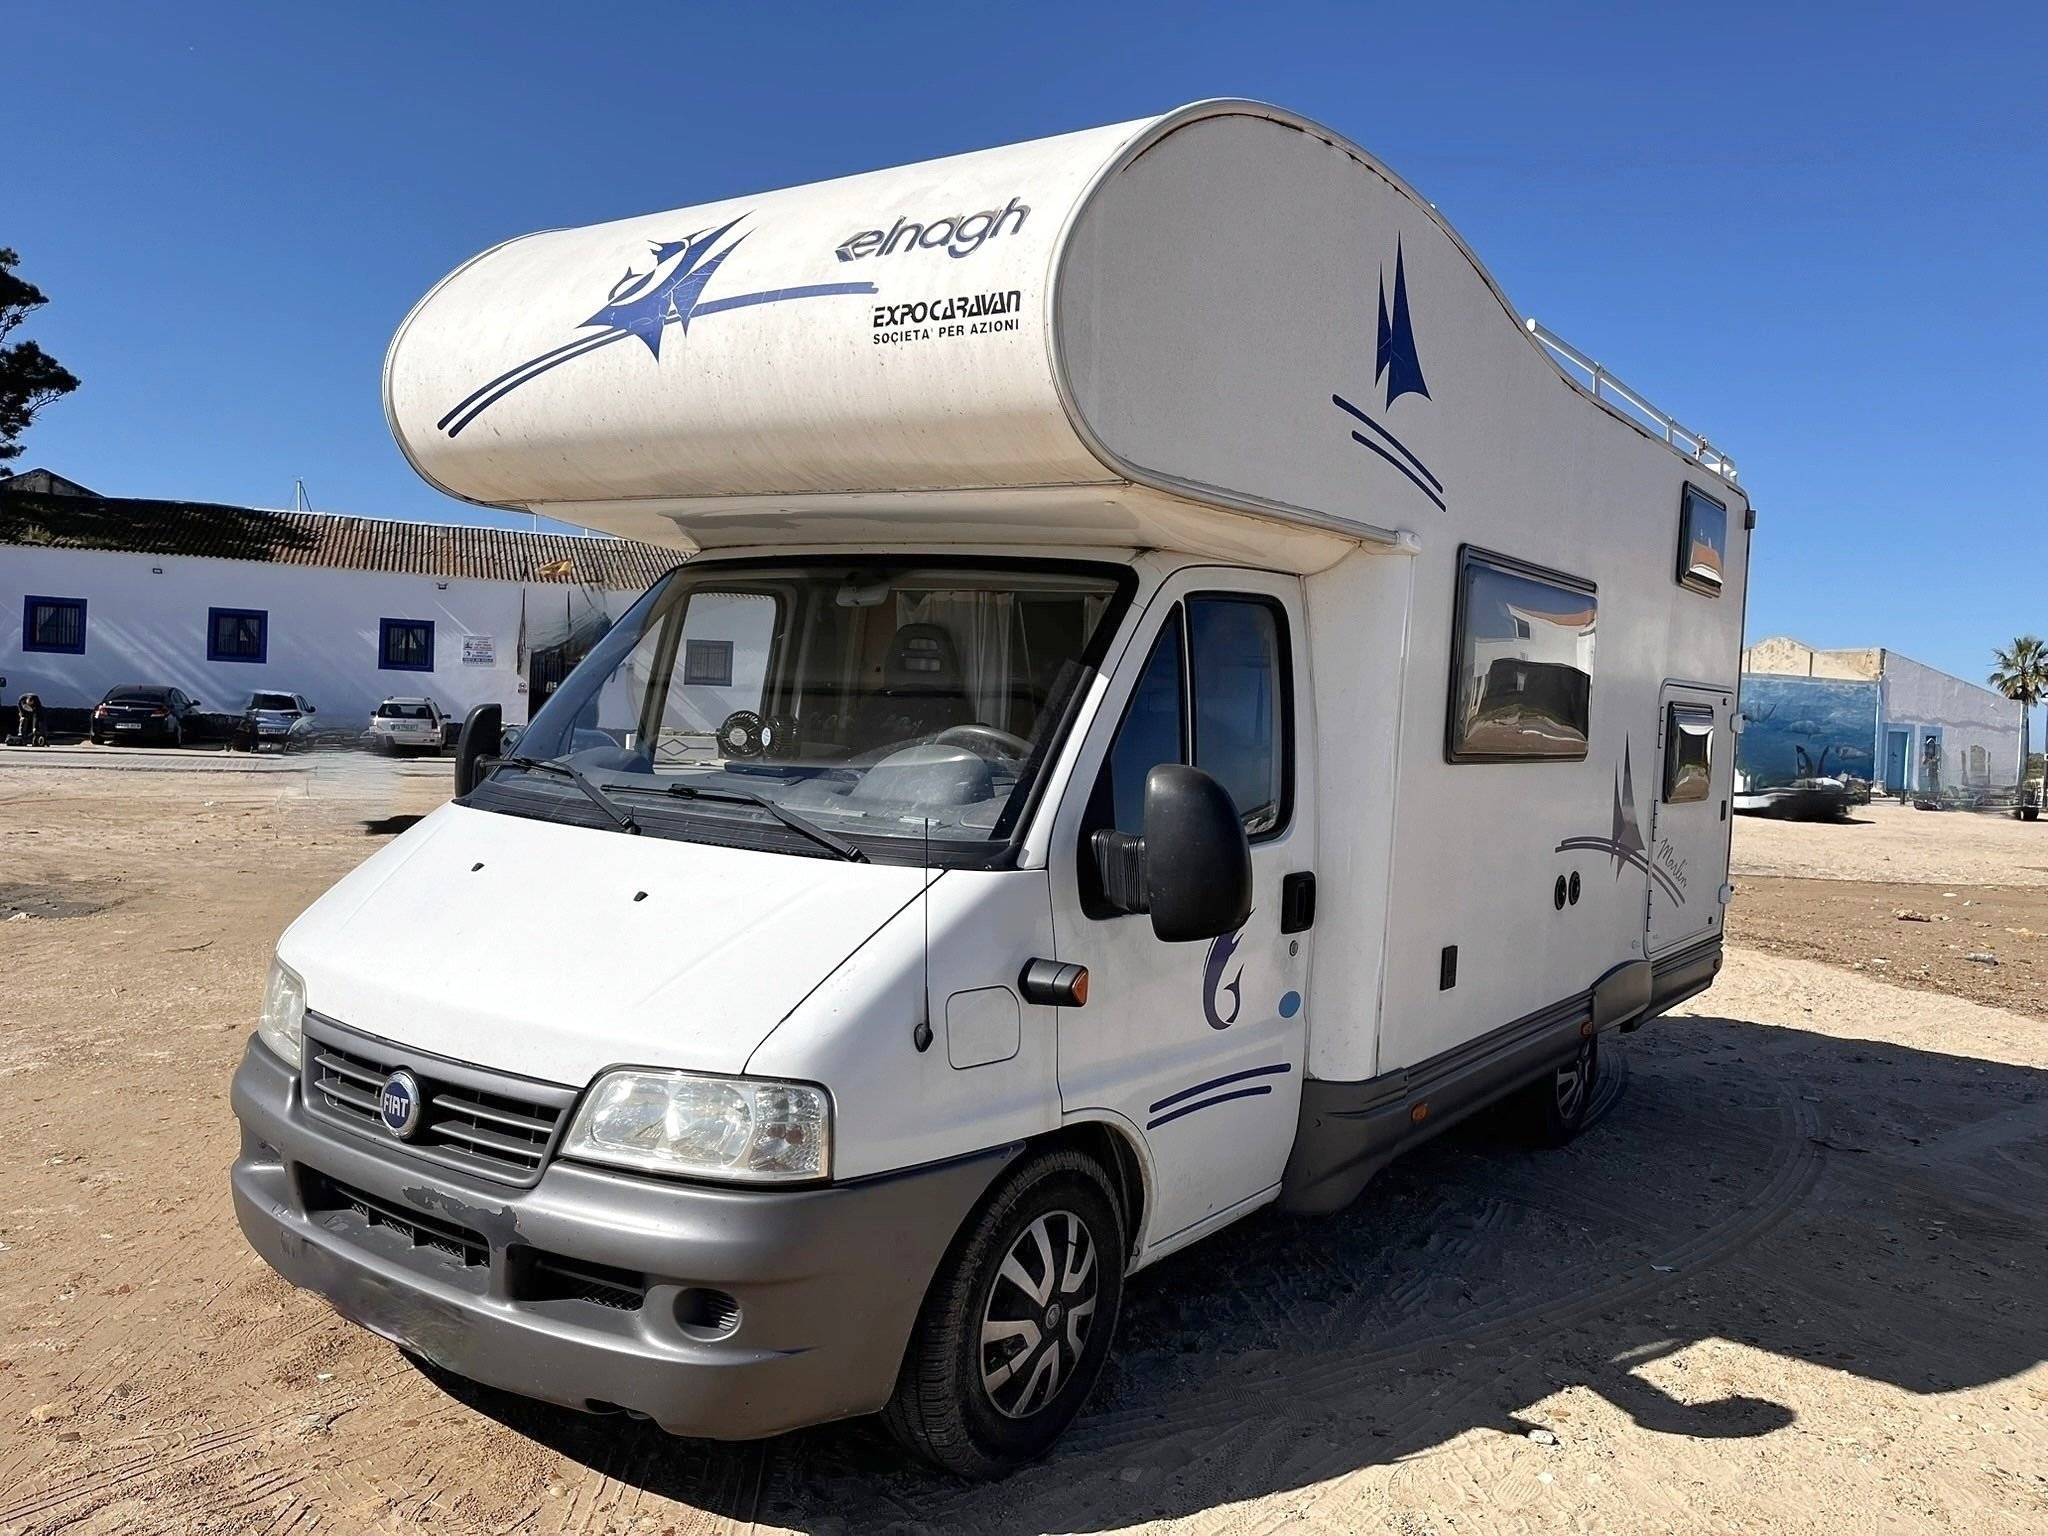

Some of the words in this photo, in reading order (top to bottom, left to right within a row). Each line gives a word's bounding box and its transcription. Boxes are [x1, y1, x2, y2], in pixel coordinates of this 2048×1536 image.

[836, 196, 1031, 262] elnagh
[938, 325, 964, 338] PER
[970, 318, 1019, 335] AZIONI
[383, 1093, 409, 1118] FIAT
